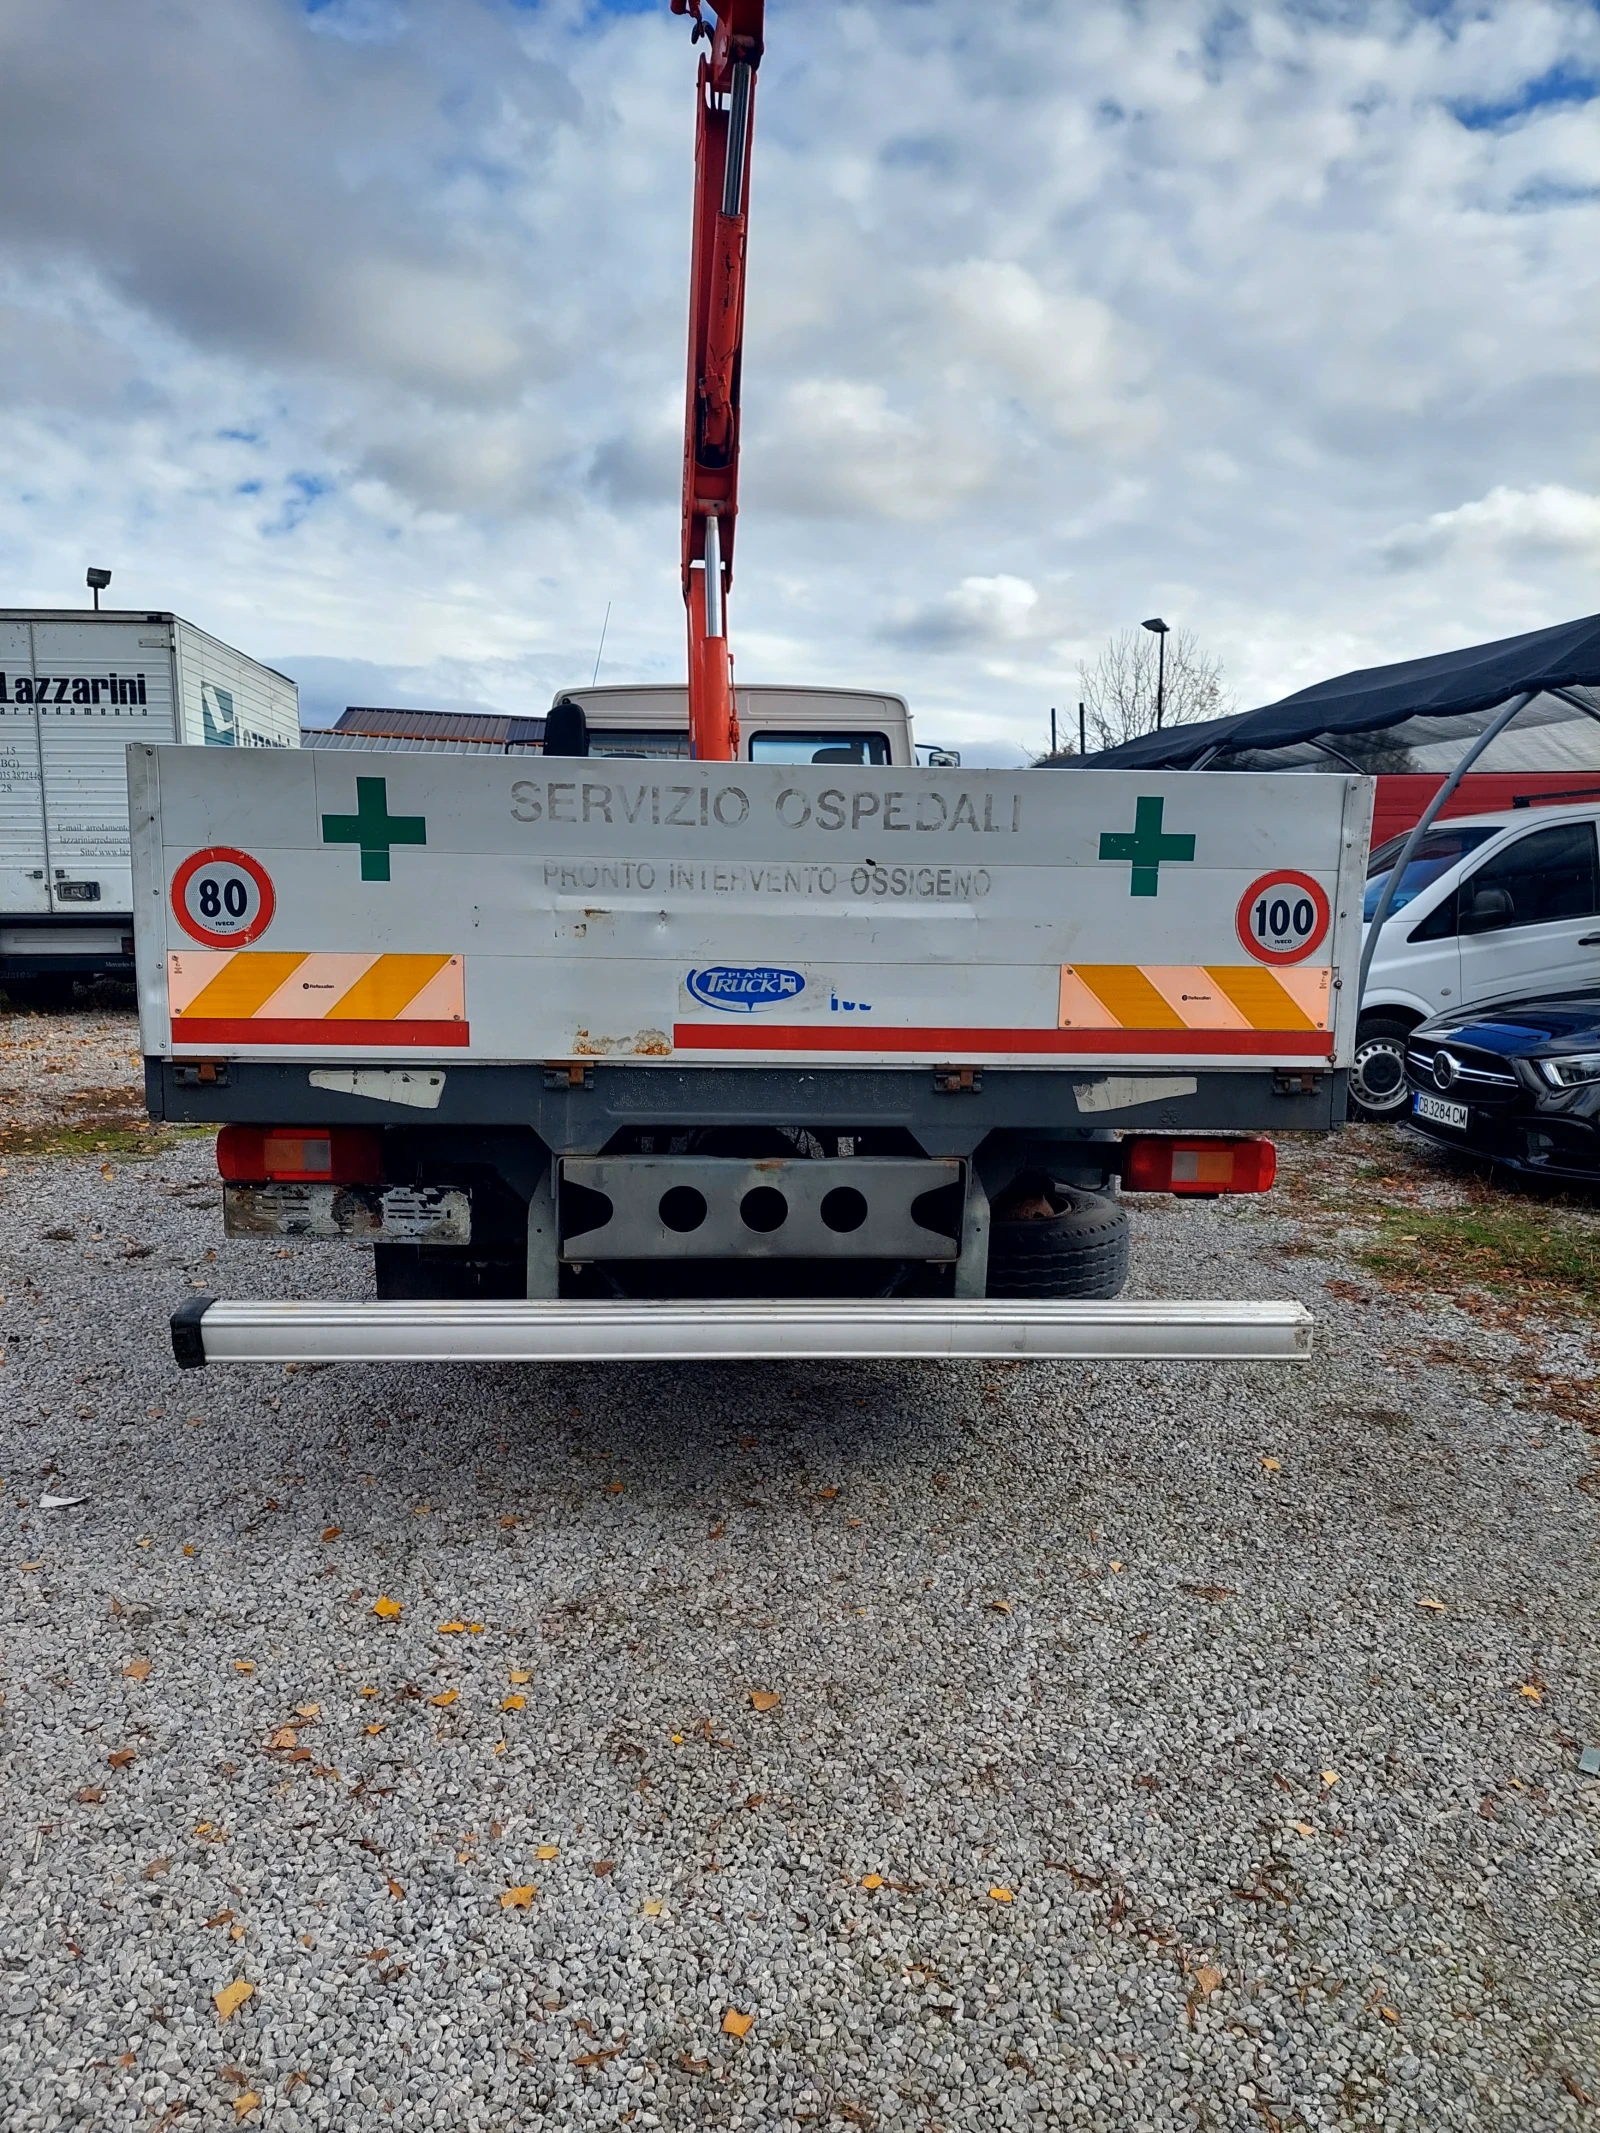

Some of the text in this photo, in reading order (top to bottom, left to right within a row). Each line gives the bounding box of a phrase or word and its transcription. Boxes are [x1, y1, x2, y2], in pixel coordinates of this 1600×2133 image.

[0, 672, 147, 705] Lazzarini
[0, 706, 147, 716] arredamento
[510, 780, 1022, 833] SERVIZIO OSPEDALI
[199, 878, 248, 918] 80
[543, 860, 992, 898] PRONTO INTERVENTO OSSIGENO
[1255, 898, 1314, 937] 100
[727, 971, 780, 979] PLANET
